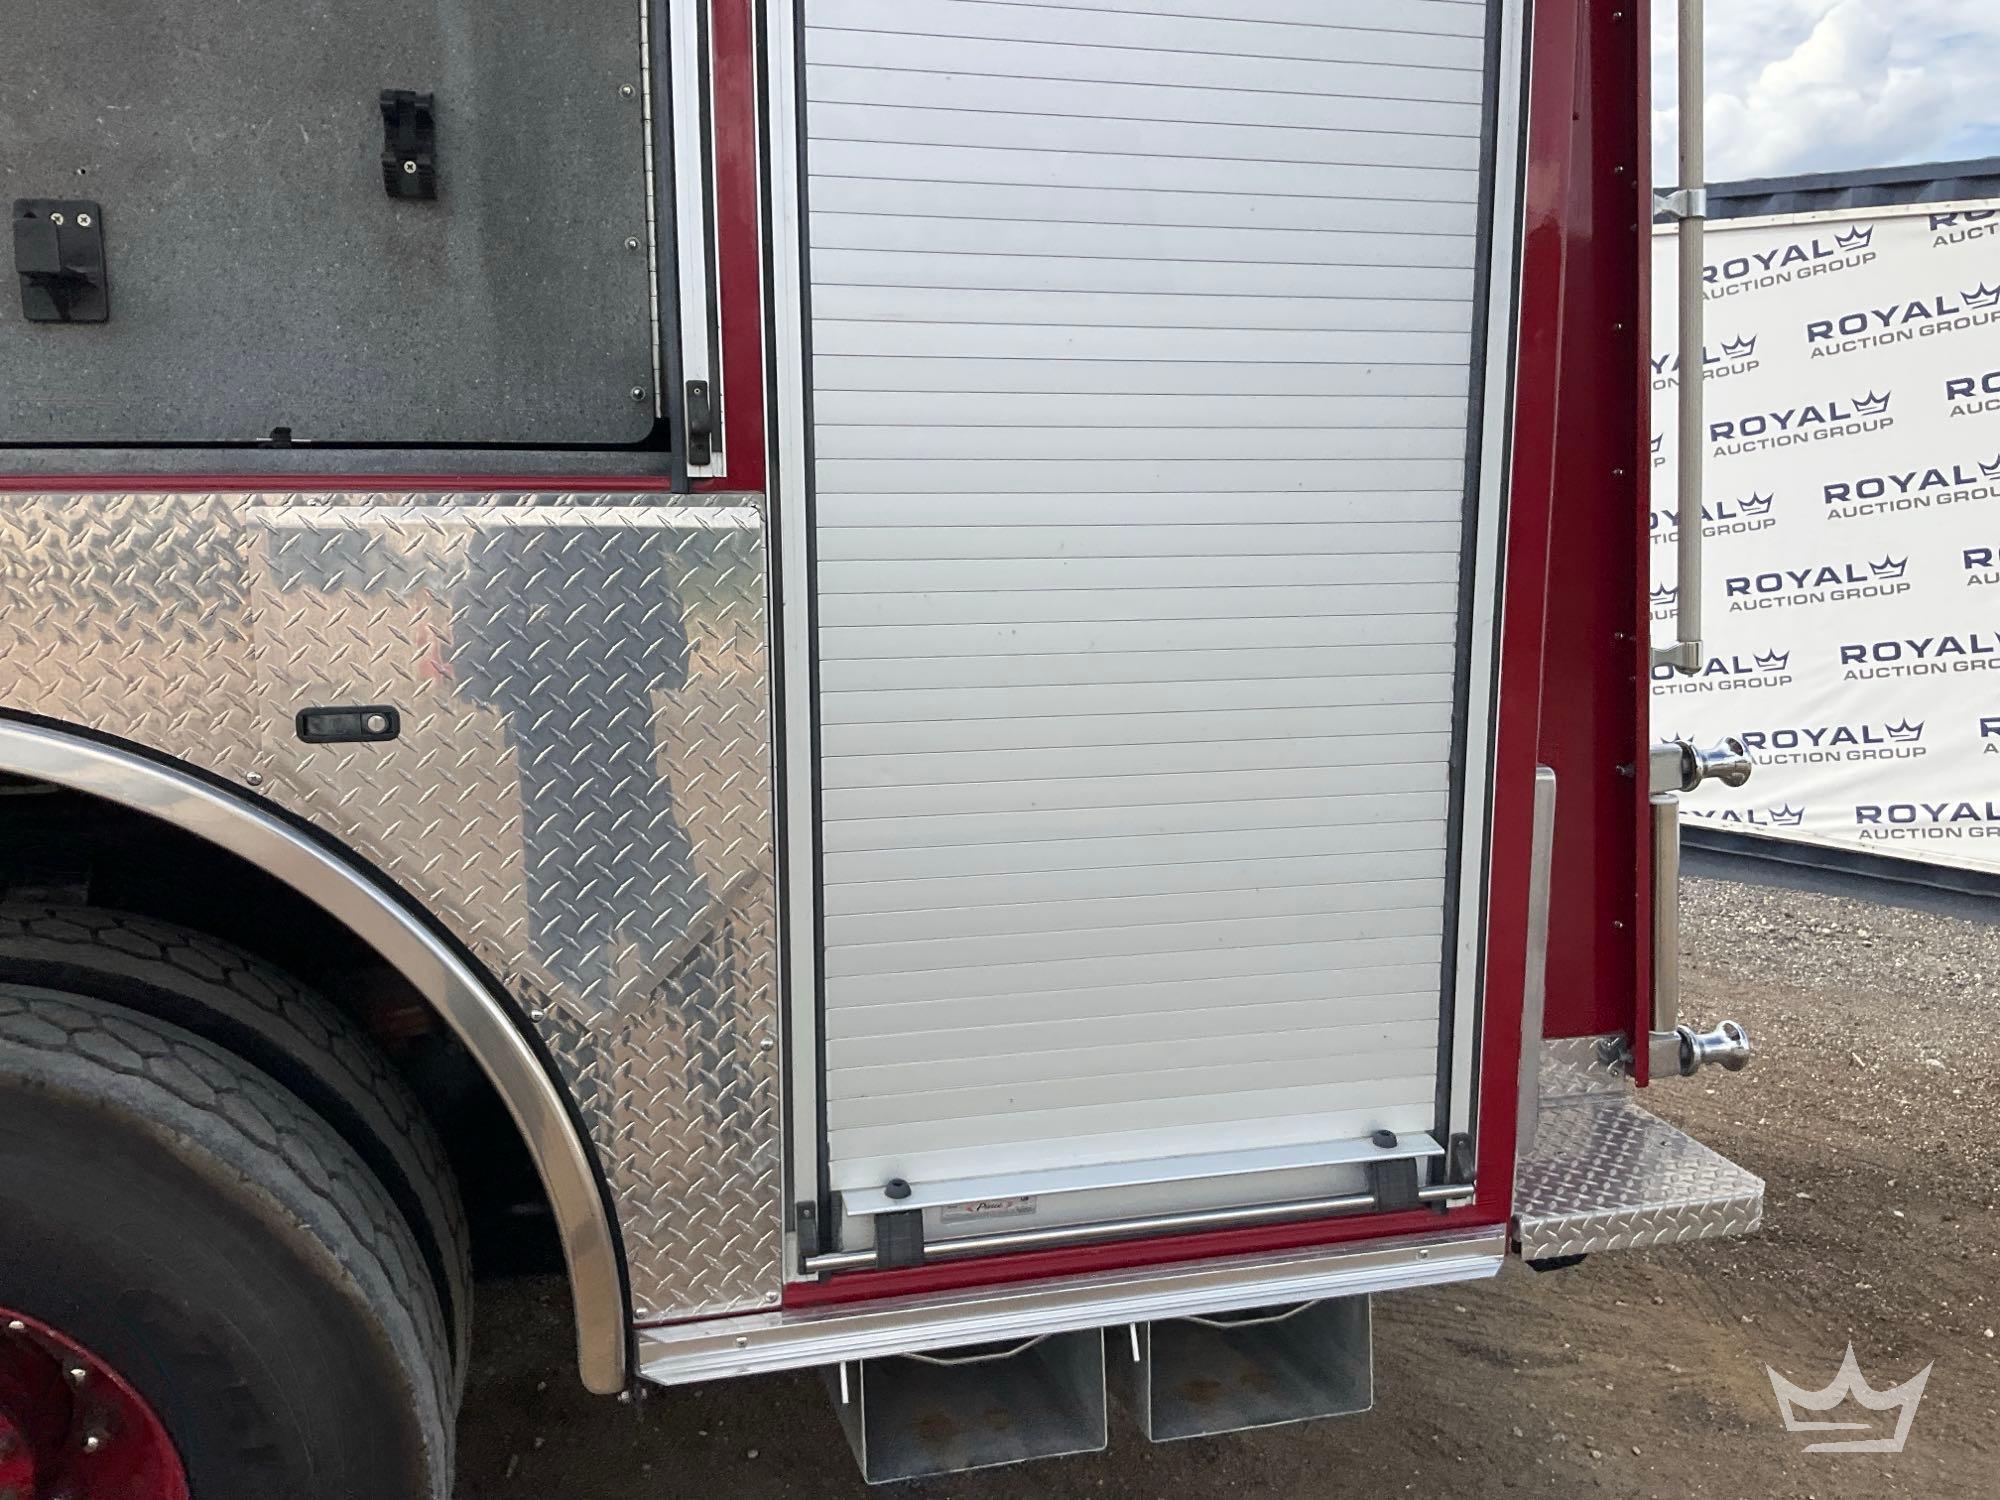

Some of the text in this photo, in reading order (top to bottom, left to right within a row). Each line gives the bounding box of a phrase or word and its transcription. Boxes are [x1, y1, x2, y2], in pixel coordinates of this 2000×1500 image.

[1932, 222, 2000, 248] AUCT
[1702, 239, 1834, 284] ROYAL
[1797, 251, 1877, 280] GROUP
[1807, 296, 1959, 343] ROYAL
[1810, 310, 2000, 359] AUCTION GROUP
[1702, 360, 1760, 380] ROUP
[1709, 401, 1851, 442] ROYAL
[1713, 417, 1894, 458] AUCTION GROUP
[1823, 464, 1977, 504] ROYAL
[1827, 486, 2000, 520] AUCTION GROU
[1702, 518, 1776, 538] GROUP
[1725, 563, 1868, 597] ROYAL
[1729, 582, 1911, 613] AUCTION GROUP
[1840, 633, 1994, 665] ROYAL
[1651, 656, 1753, 681] OAL
[1843, 658, 2000, 681] AUCTION GRO
[1652, 675, 1793, 696] CTION GROUP
[1741, 724, 1884, 750] ROYAL
[1846, 747, 1927, 761] GROUP
[1856, 802, 2000, 824] ROYAL
[1859, 828, 1963, 840] AUCTION
